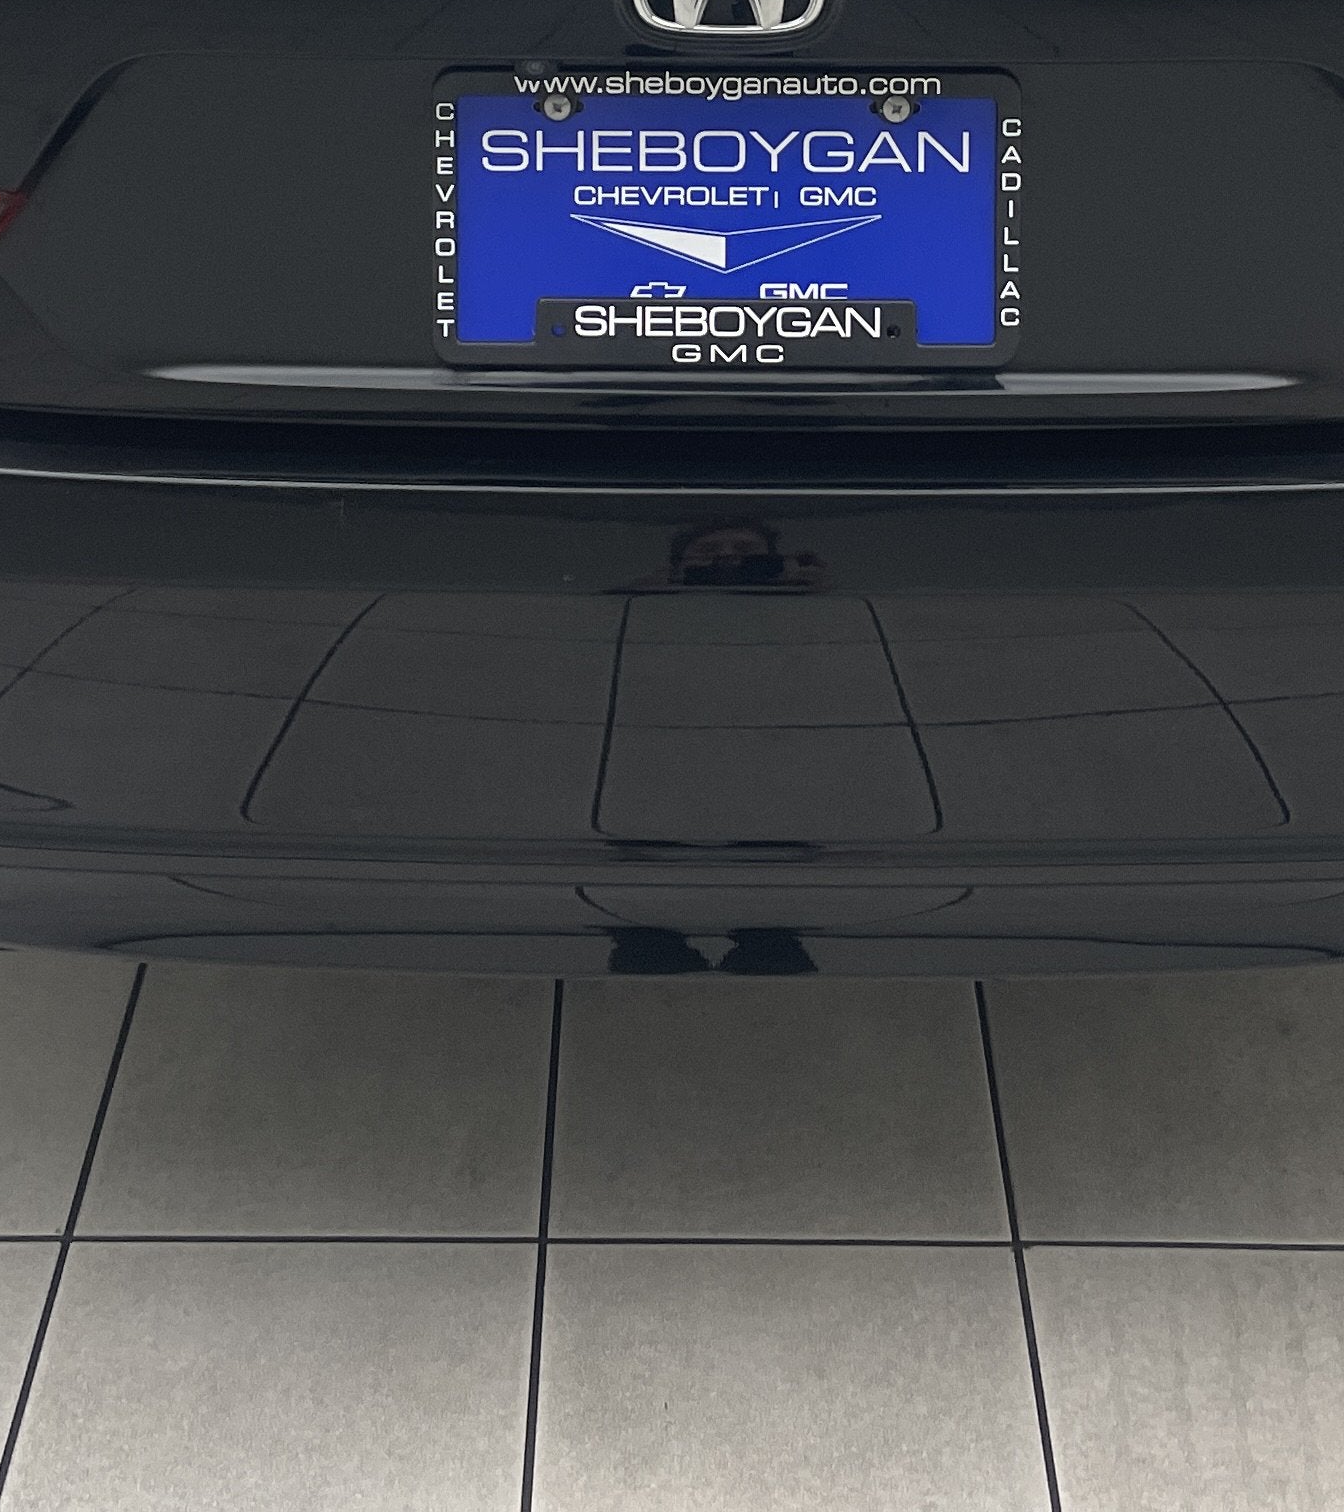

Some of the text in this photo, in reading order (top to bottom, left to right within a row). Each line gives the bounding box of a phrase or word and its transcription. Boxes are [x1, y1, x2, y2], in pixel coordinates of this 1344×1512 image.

[513, 70, 942, 101] www.sheboyganauto.com
[480, 129, 971, 173] SHEBOYGAN
[573, 185, 877, 207] CHEVROLET GMC
[434, 102, 456, 338] CHEVROLET
[999, 118, 1022, 327] CADILLAC
[759, 283, 849, 300] GMC
[573, 305, 882, 339] SHEBOYGAN
[671, 344, 785, 364] GMC
